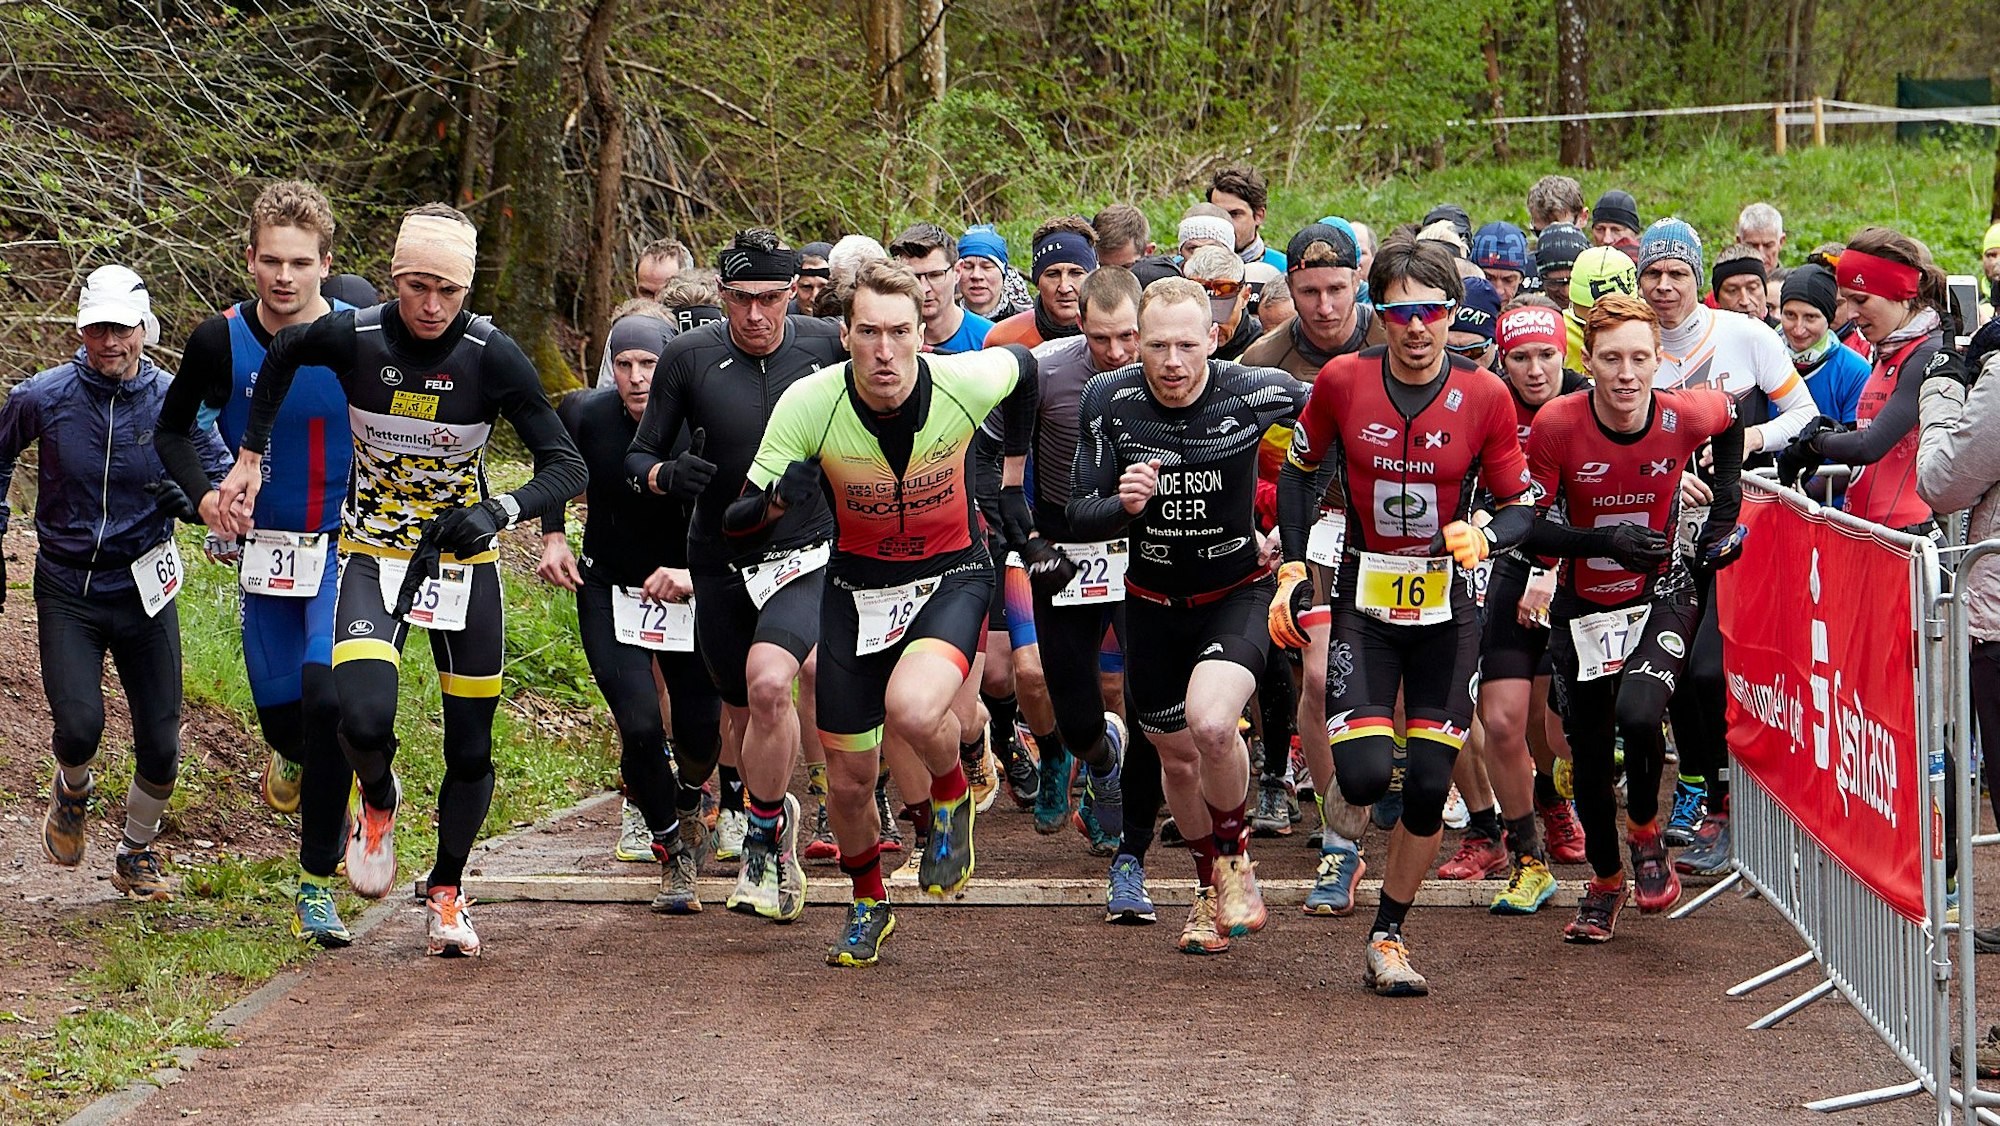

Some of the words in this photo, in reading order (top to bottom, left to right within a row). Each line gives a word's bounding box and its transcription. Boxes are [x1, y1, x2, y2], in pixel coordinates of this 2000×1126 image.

[1502, 310, 1555, 334] HOKA
[425, 380, 453, 390] FELD
[1373, 455, 1435, 474] FROHN
[846, 484, 955, 516] BoConcept
[848, 490, 872, 498] 352
[1592, 493, 1656, 507] HOLDER
[156, 552, 175, 584] 68
[270, 549, 295, 577] 31
[773, 556, 802, 580] 25
[1078, 558, 1109, 585] 22
[1391, 576, 1426, 607] 16
[640, 604, 666, 630] 72
[889, 601, 913, 630] 18
[1600, 630, 1629, 659] 17
